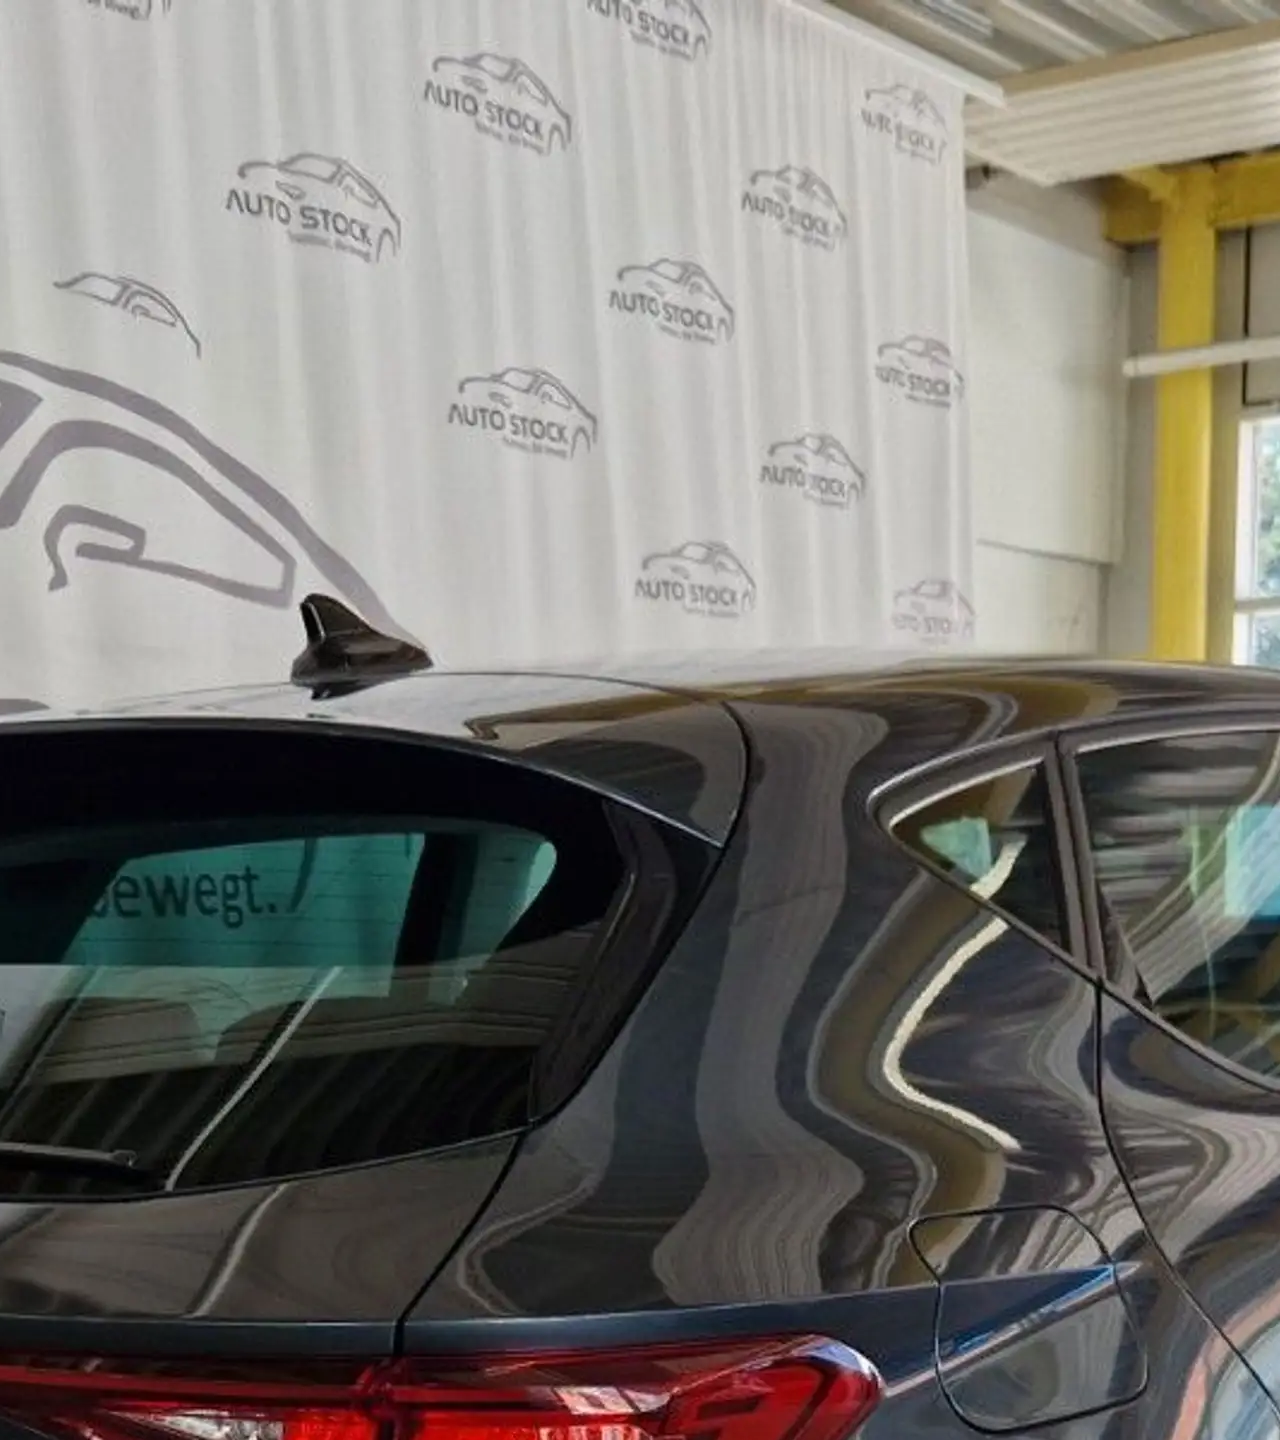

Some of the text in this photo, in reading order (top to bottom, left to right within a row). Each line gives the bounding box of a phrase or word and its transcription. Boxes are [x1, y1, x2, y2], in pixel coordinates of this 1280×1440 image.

[423, 79, 479, 117] AUTO
[484, 100, 544, 141] STOCK
[225, 188, 292, 226] AUTO
[299, 204, 373, 247] STOCK
[608, 289, 714, 332] AUTO STOCK
[447, 402, 569, 444] AUTO STOCK
[634, 576, 686, 602] AUTO
